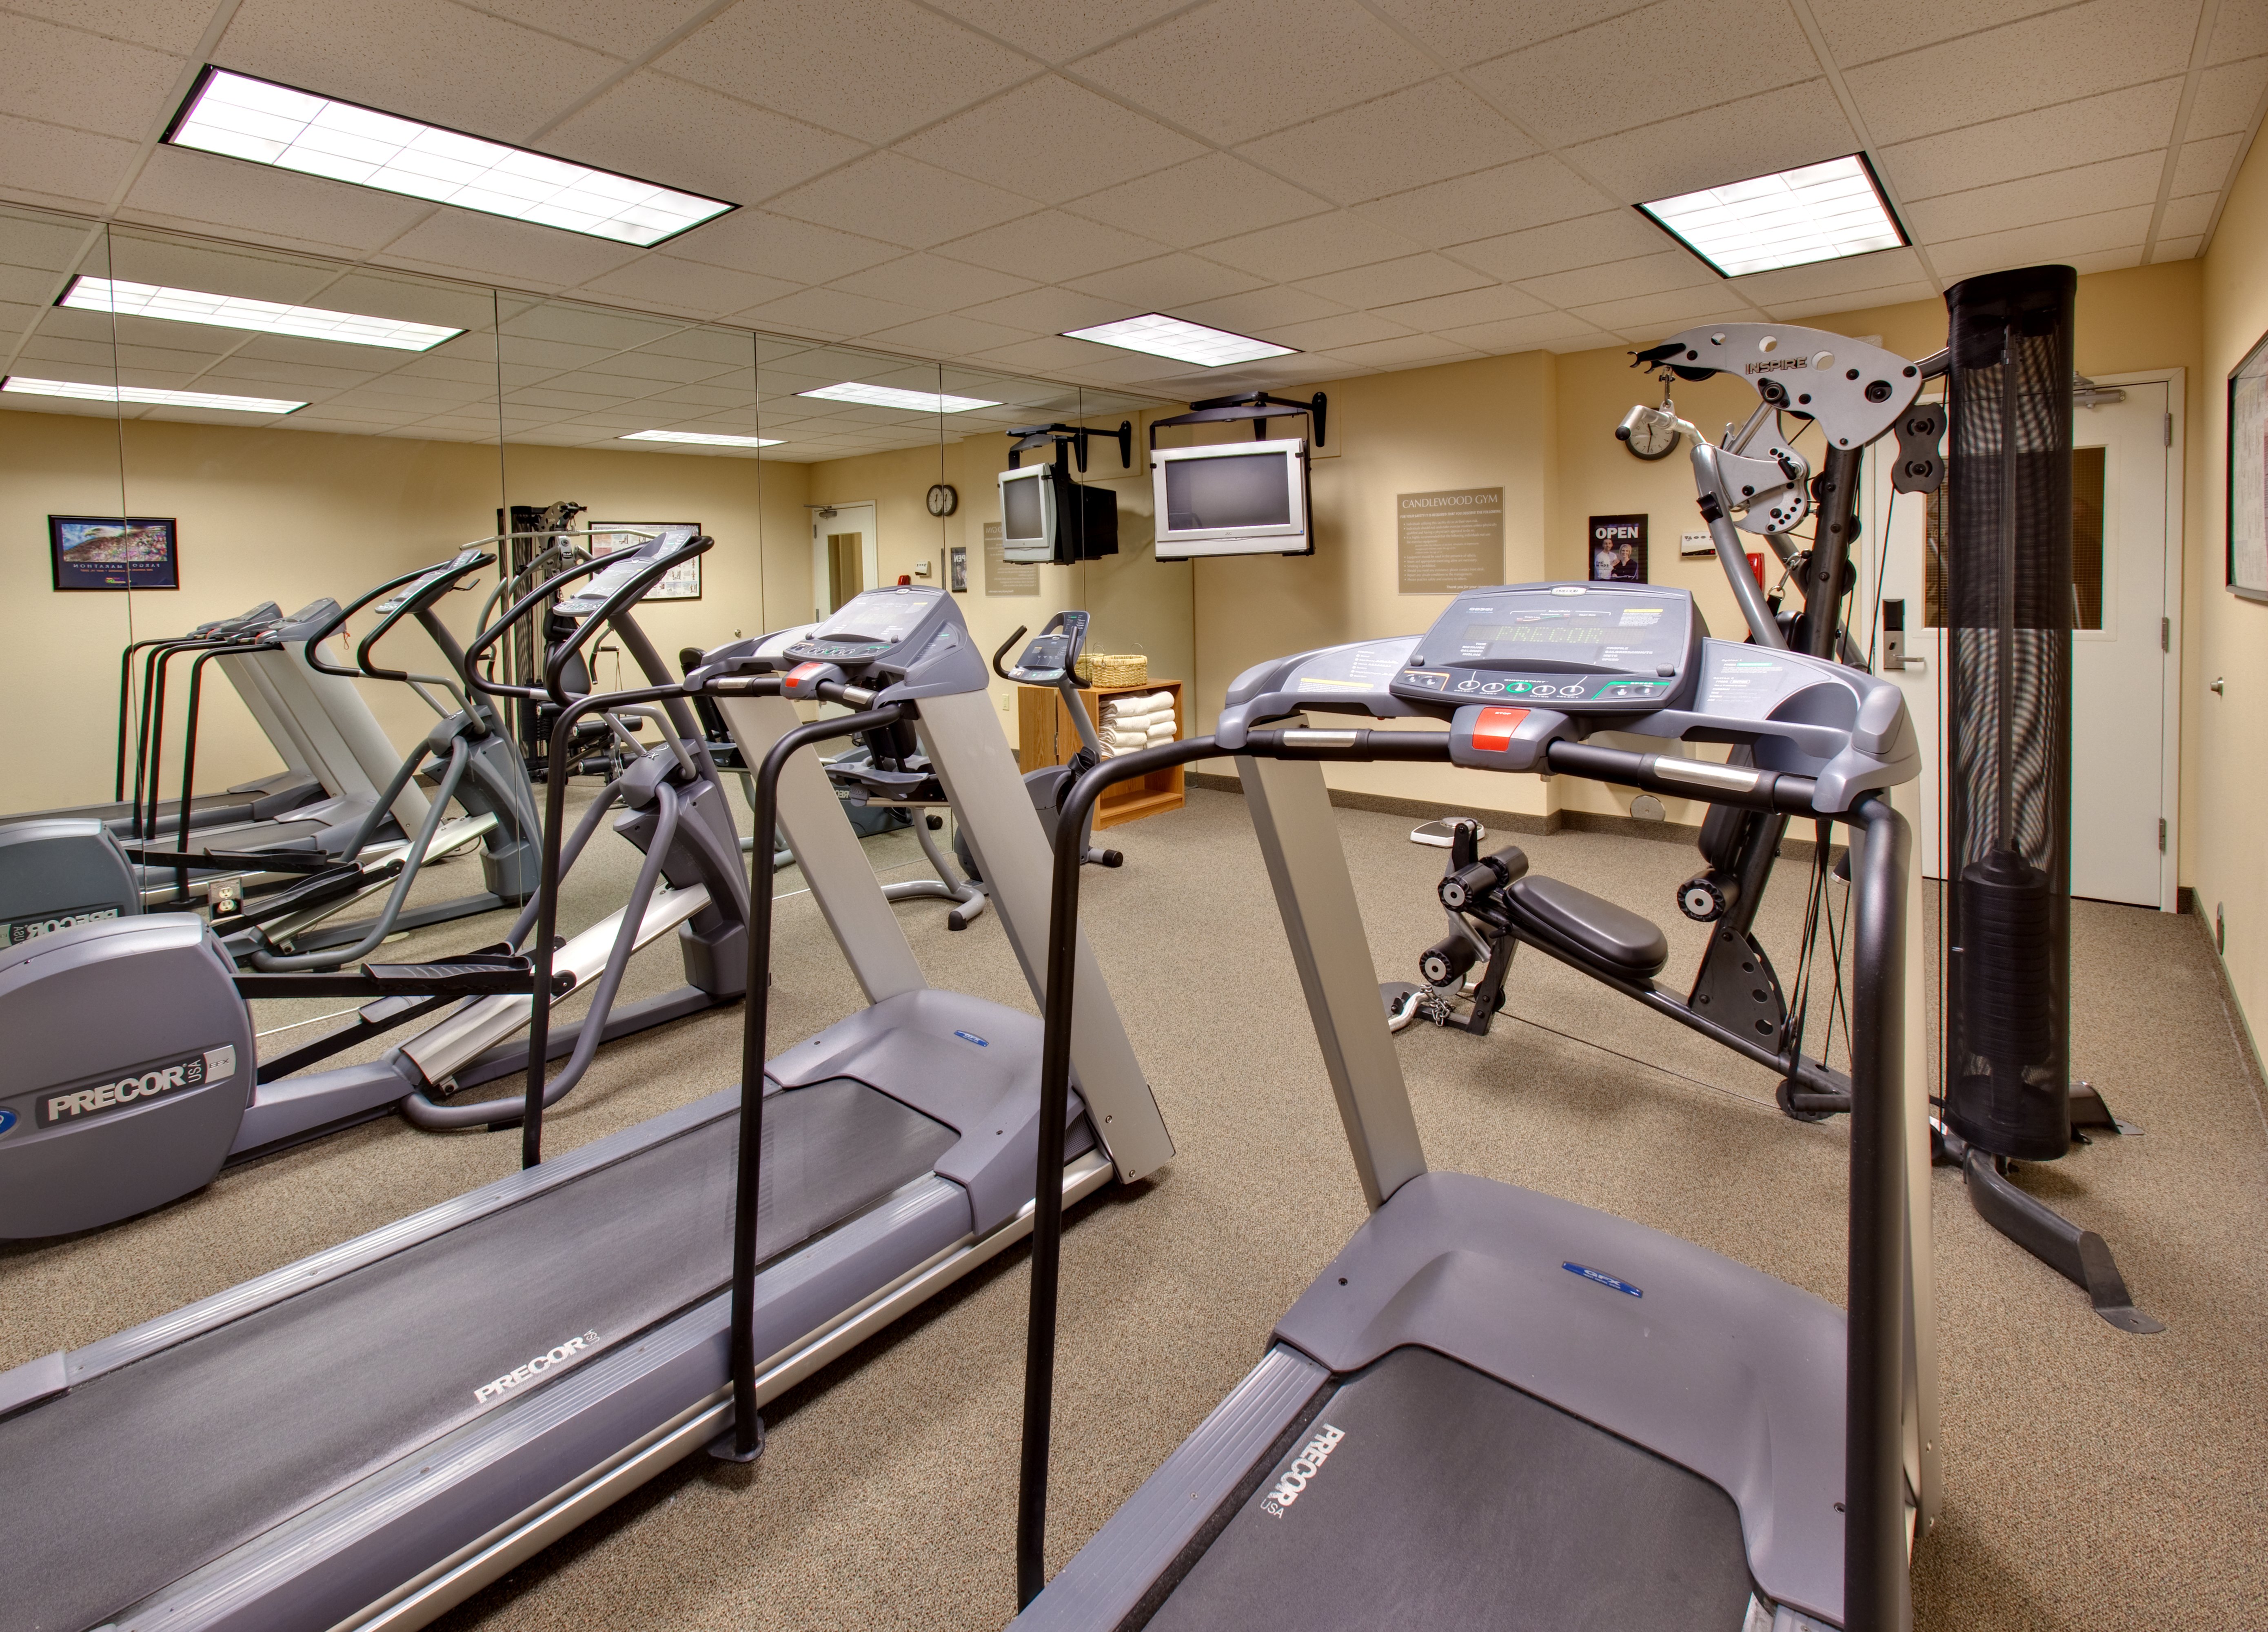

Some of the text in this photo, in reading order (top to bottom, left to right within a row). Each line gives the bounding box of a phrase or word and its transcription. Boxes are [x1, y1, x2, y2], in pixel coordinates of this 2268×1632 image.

[1746, 357, 1807, 374] INSPIRE
[1402, 494, 1498, 508] CANDLEWOOD GYM
[1596, 527, 1638, 539] OPEN
[1495, 626, 1604, 643] PRECOR
[49, 1058, 230, 1121] PRECOR USA EFX
[1584, 1270, 1621, 1286] GFX
[474, 1328, 600, 1404] PRECOR USA
[1260, 1423, 1345, 1519] PRECOR USA
